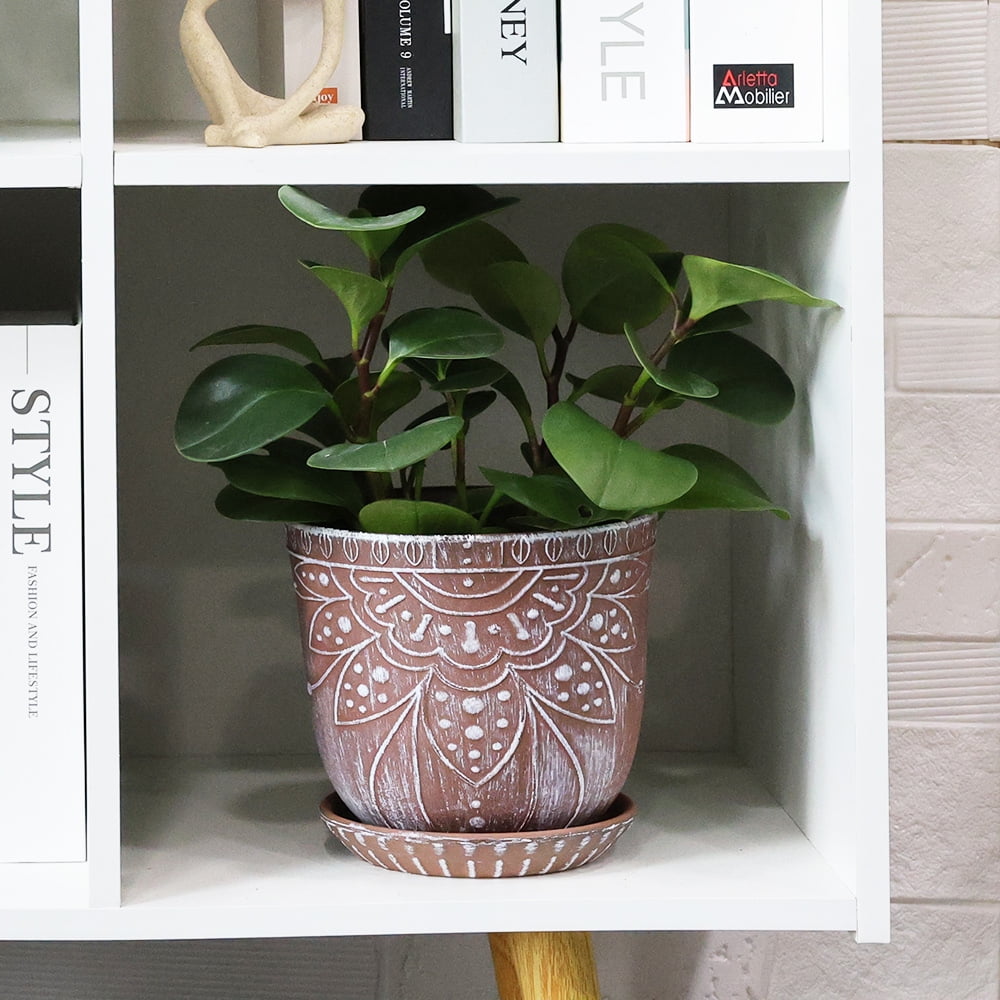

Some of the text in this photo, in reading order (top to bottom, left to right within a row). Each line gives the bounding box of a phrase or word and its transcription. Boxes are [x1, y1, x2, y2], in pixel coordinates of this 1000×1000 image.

[399, 51, 412, 59] 9
[722, 69, 778, 87] Arletta
[715, 86, 790, 105] Mobilier
[10, 388, 52, 719] STYLE FASHION AND LIFESTYLE
